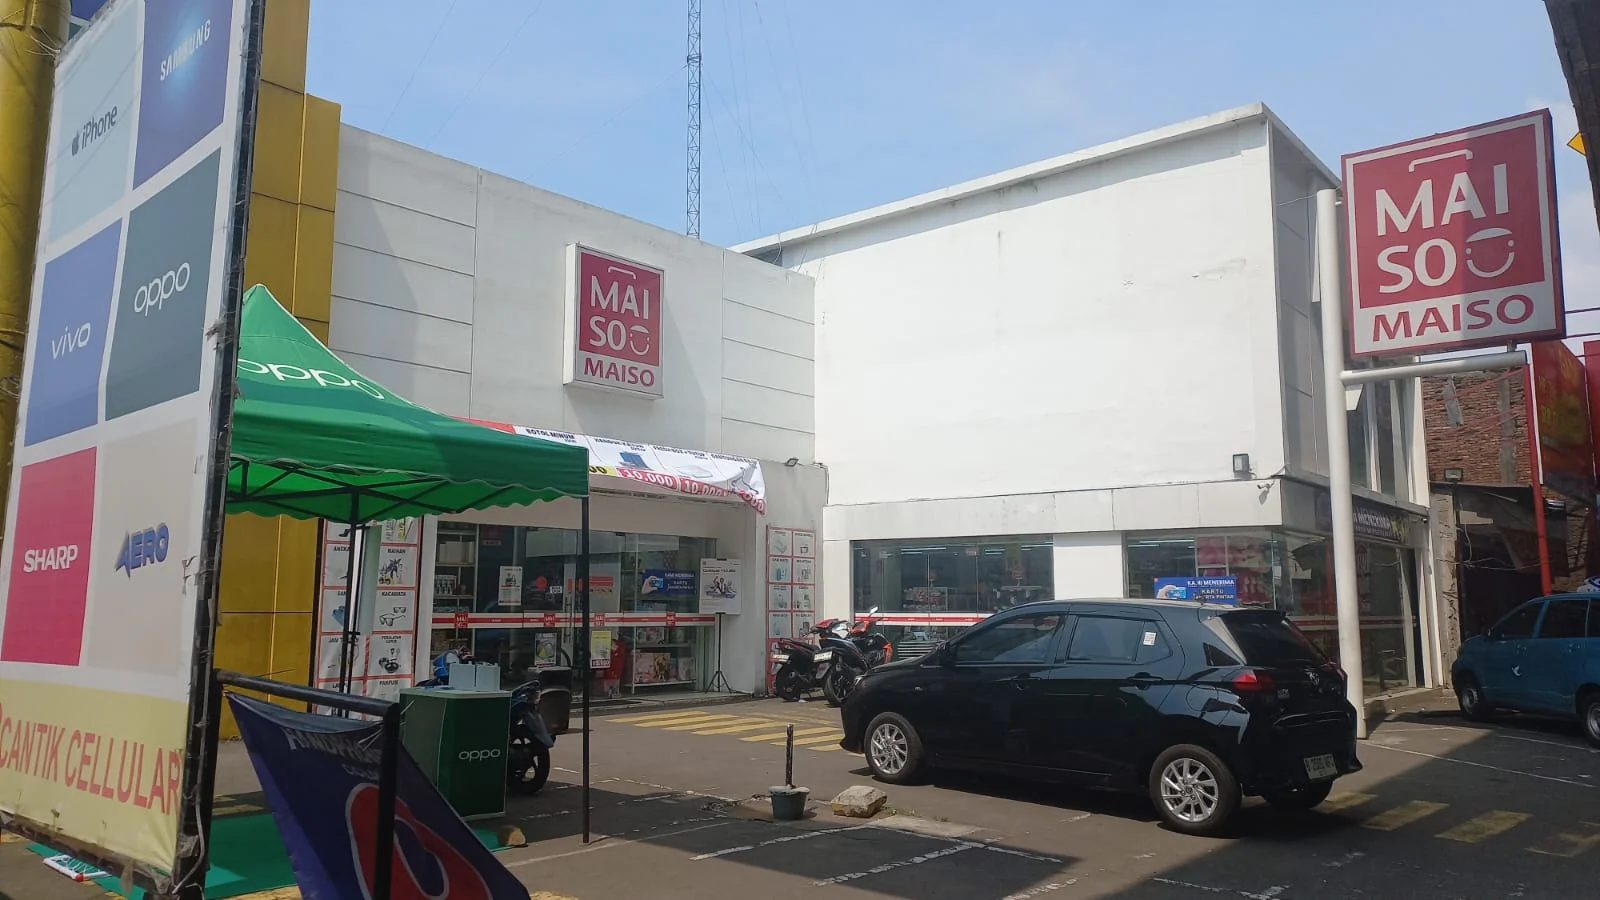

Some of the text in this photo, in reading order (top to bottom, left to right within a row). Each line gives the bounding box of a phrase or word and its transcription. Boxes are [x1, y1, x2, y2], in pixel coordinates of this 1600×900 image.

[159, 19, 211, 81] SAMSUNG
[81, 105, 118, 150] iPhone
[1375, 163, 1509, 236] MAI
[133, 262, 190, 316] oppo
[590, 275, 649, 320] MAI
[1372, 294, 1534, 342] MAISO
[51, 322, 91, 360] vivo
[237, 359, 385, 400] oppo
[583, 357, 655, 387] MAISO
[23, 544, 79, 573] SHARP
[114, 522, 170, 579] AERO
[0, 716, 183, 816] CANTIK CELLULAR
[458, 748, 501, 763] oppo
